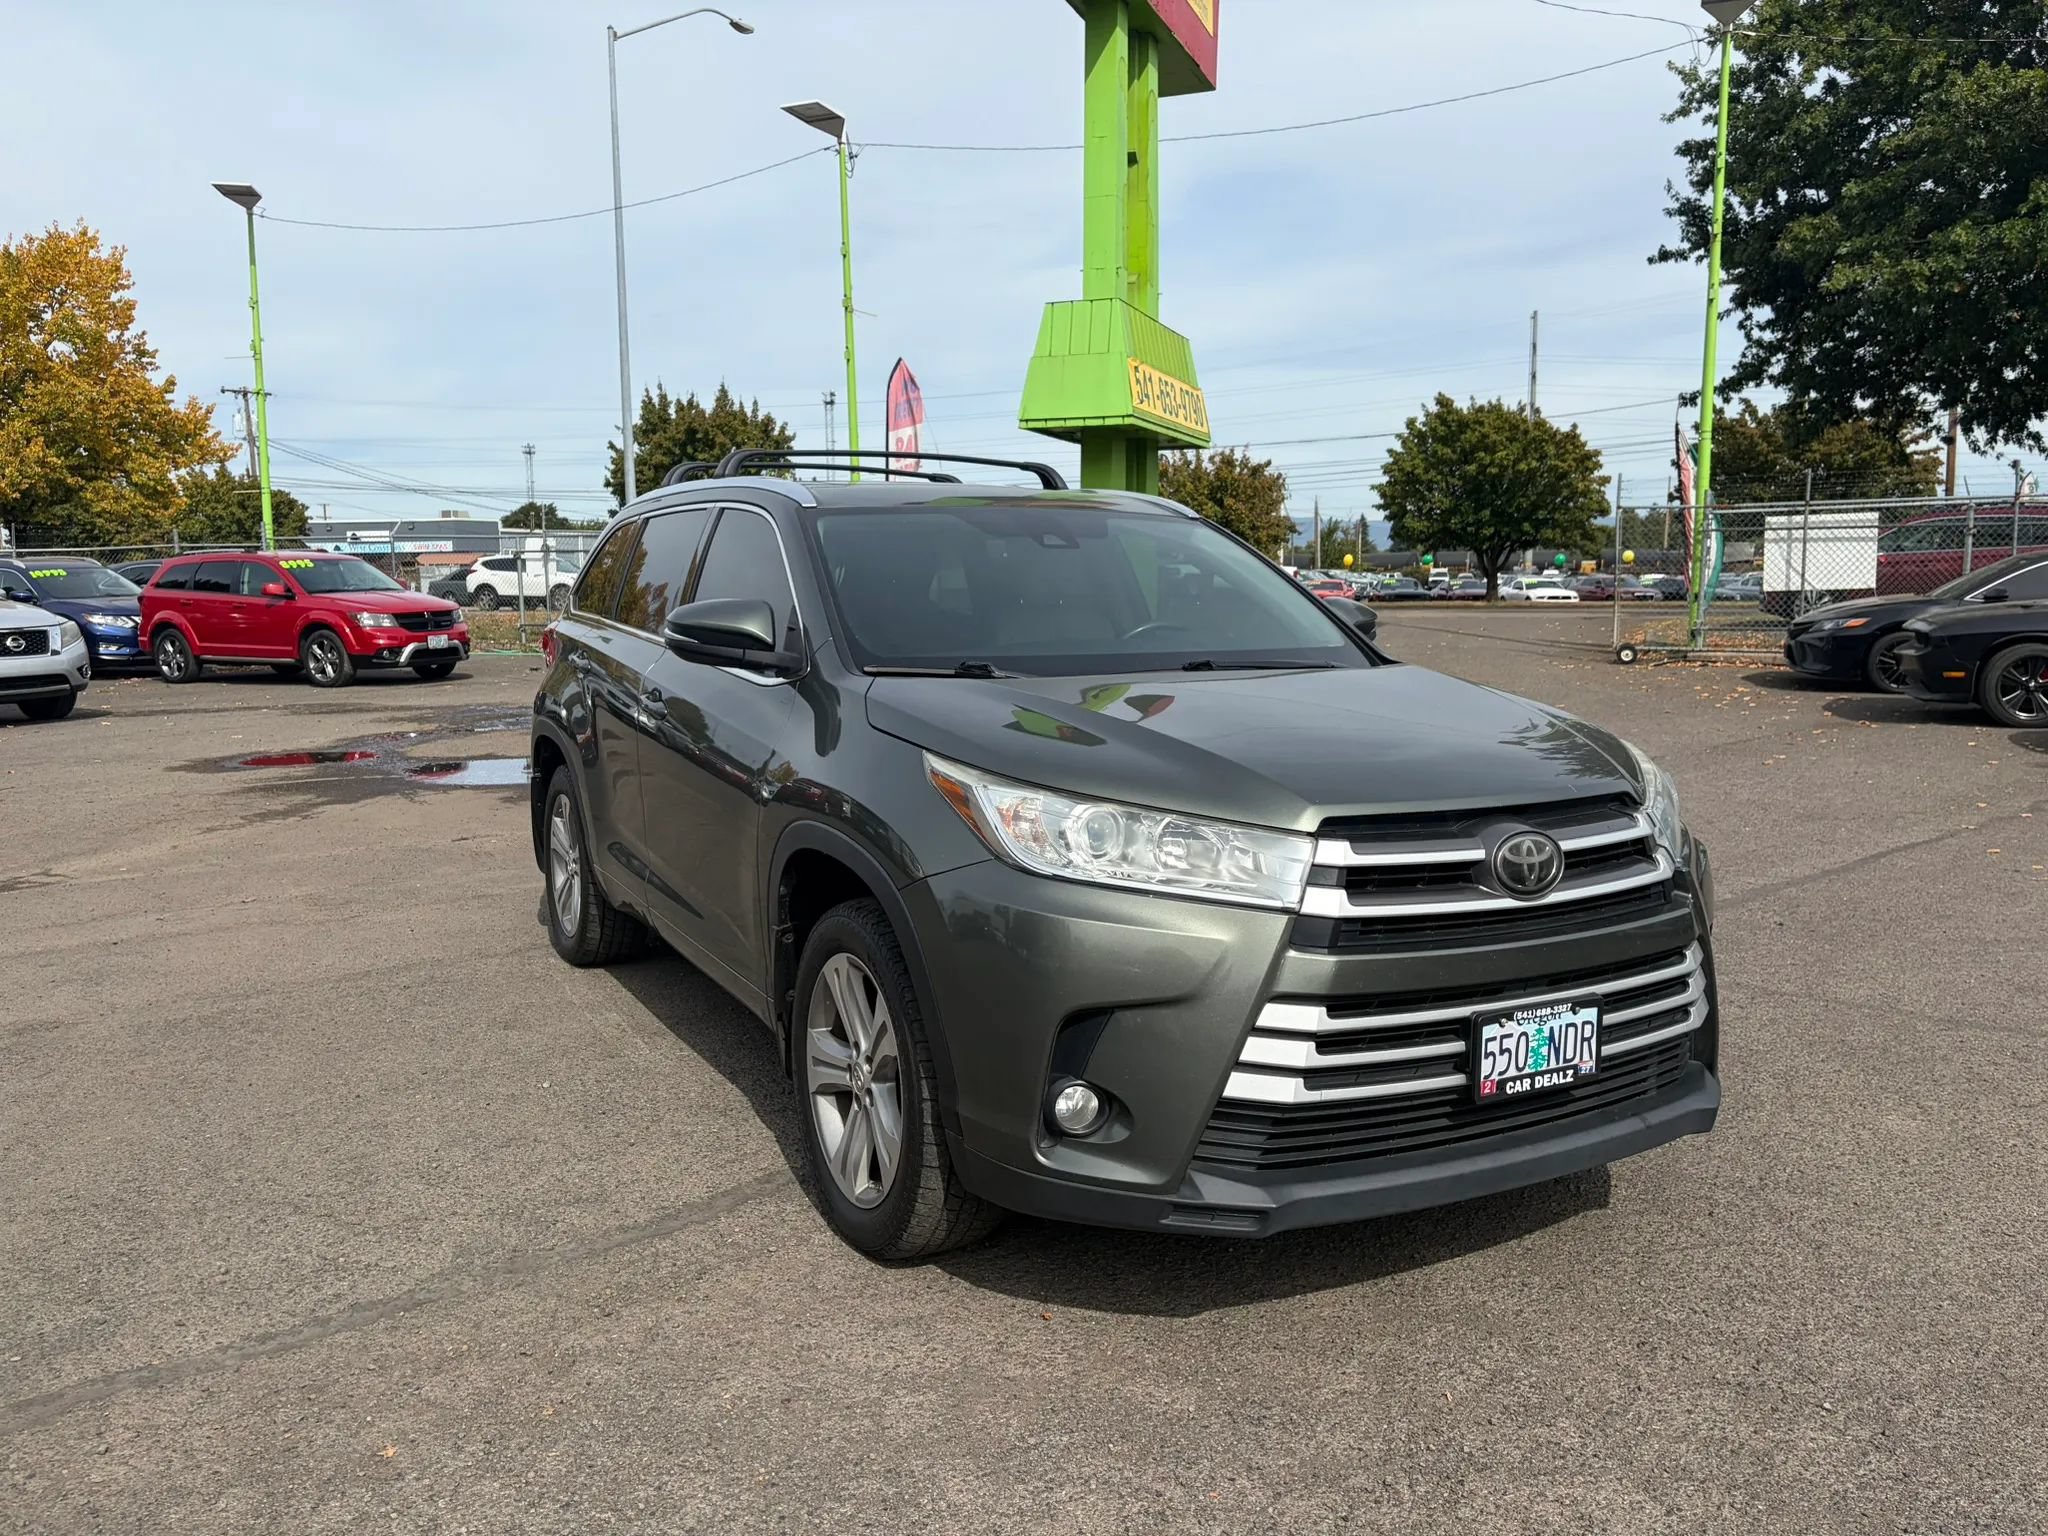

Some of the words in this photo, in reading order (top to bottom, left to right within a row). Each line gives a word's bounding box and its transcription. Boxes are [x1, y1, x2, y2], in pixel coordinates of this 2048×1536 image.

[1483, 1031, 1530, 1080] 550
[1547, 1020, 1595, 1067] NDR
[1483, 1081, 1492, 1094] 2
[1505, 1079, 1532, 1095] CAR
[1534, 1069, 1575, 1089] DEALZ
